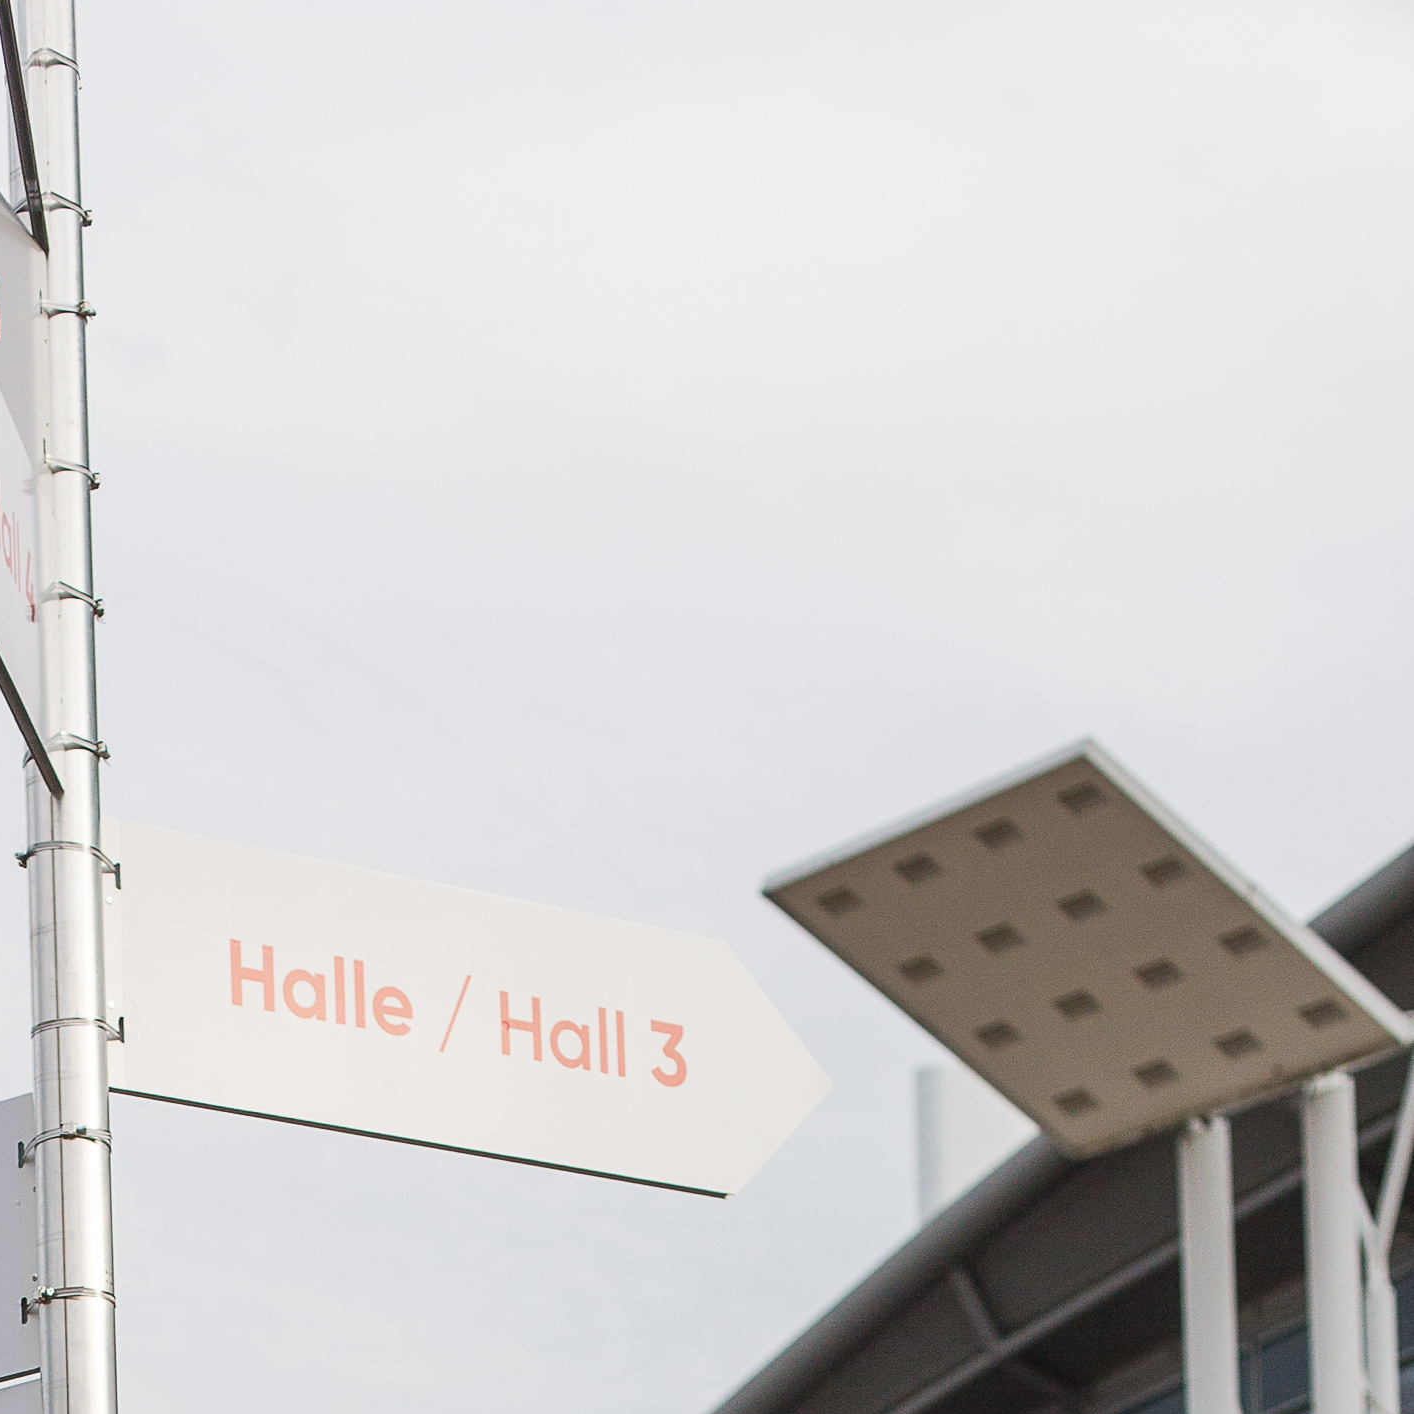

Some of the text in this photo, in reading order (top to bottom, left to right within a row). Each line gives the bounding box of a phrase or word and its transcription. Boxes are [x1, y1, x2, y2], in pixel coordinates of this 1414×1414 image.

[229, 938, 688, 1088] Halle / Hall 3
